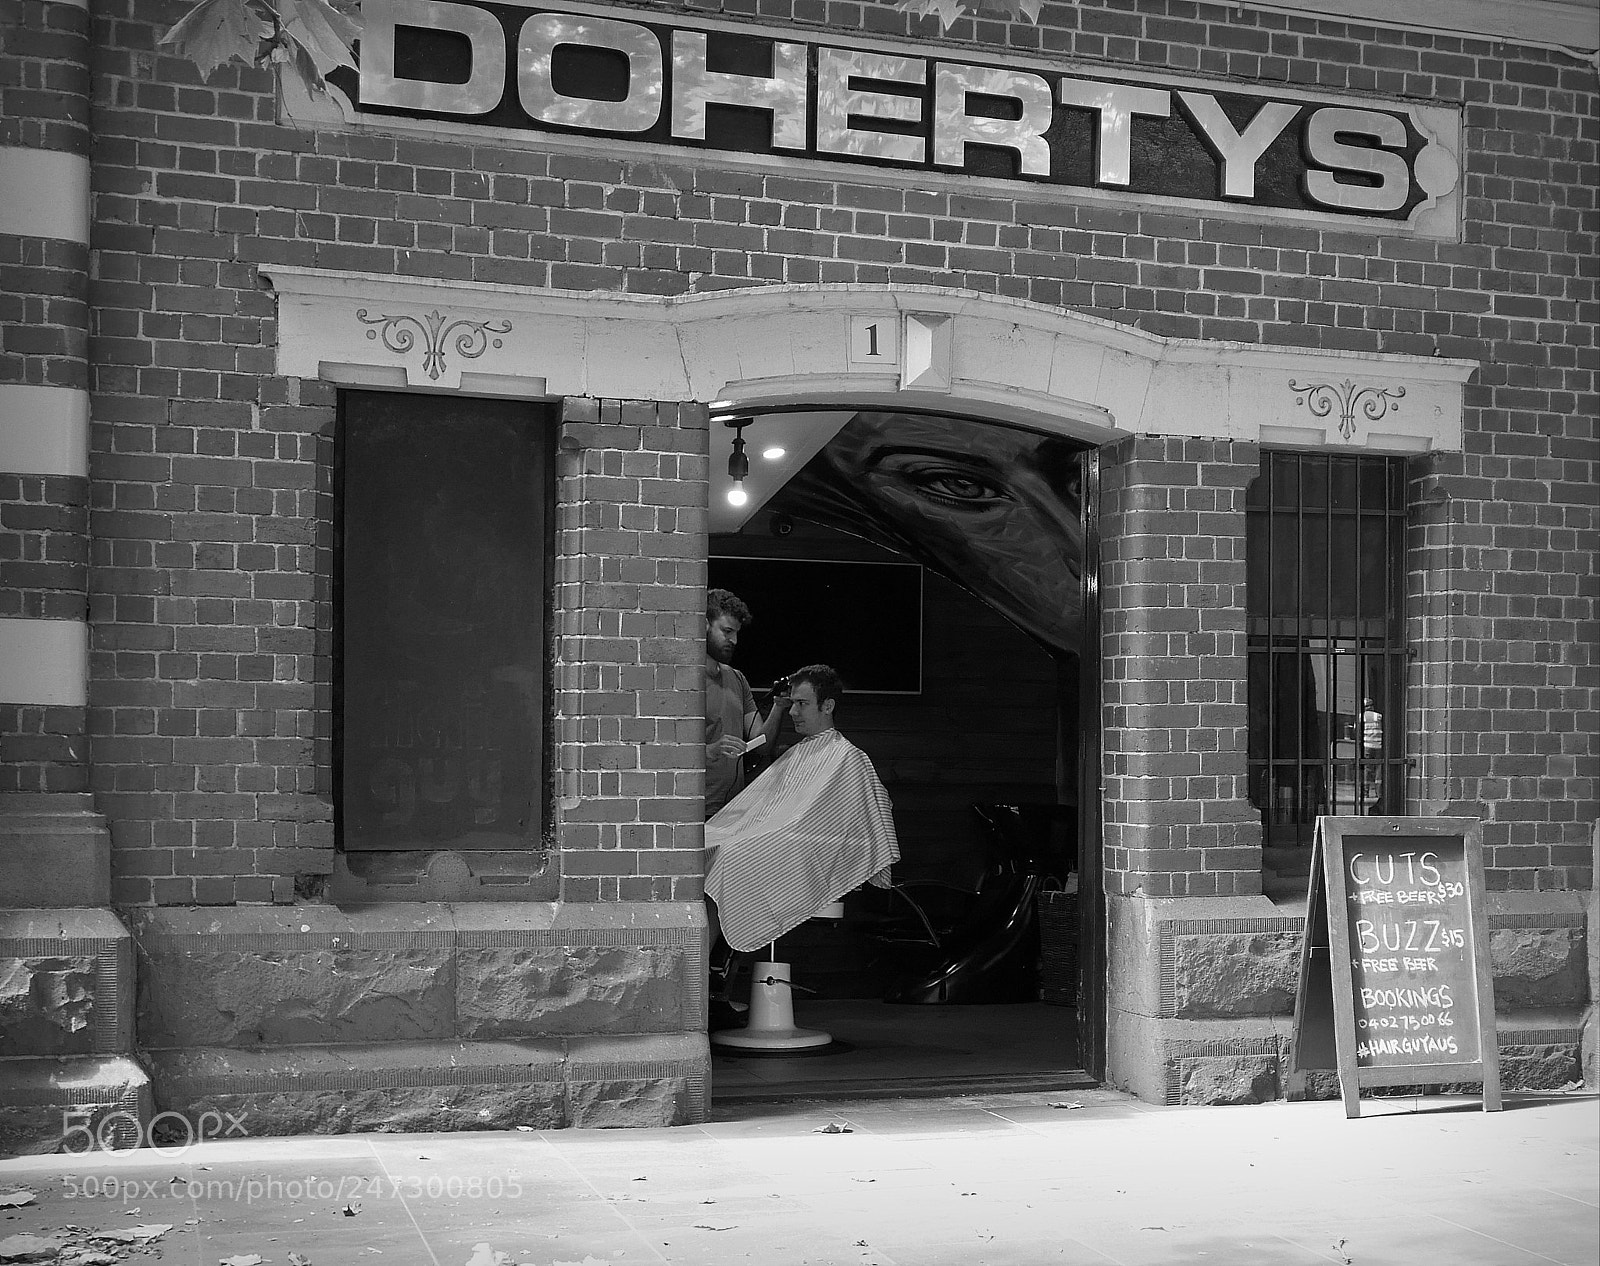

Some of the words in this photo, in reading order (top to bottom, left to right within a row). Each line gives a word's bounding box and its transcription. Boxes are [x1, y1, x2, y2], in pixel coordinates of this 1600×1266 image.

[356, 0, 1410, 211] DOHERTYS
[864, 323, 882, 356] 1
[1350, 852, 1441, 887] CUTS
[1360, 890, 1394, 905] FREE
[1396, 890, 1440, 905] BEER
[1437, 881, 1464, 903] $30
[1356, 919, 1442, 954] BUZZ
[1441, 928, 1464, 948] $15
[1361, 957, 1399, 972] FREE
[1402, 956, 1438, 971] BEER
[1360, 984, 1453, 1009] BOOKINGS
